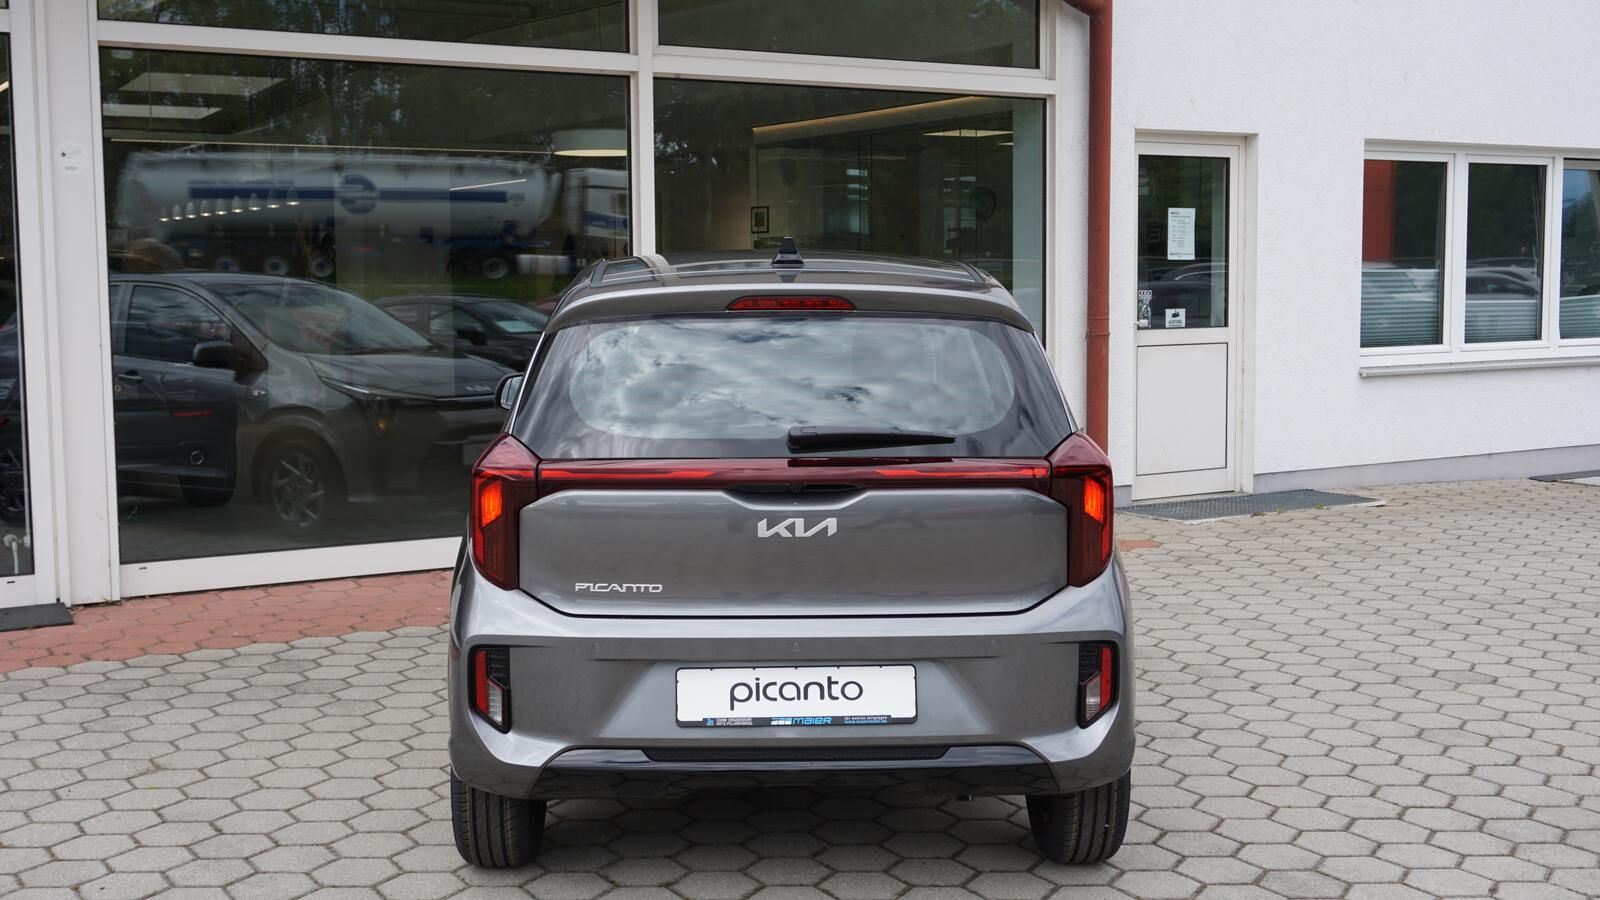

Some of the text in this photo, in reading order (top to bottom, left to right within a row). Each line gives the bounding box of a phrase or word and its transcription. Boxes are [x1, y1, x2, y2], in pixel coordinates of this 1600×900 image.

[757, 517, 837, 538] KIA
[574, 582, 663, 593] PICANTO
[729, 676, 863, 711] picanto
